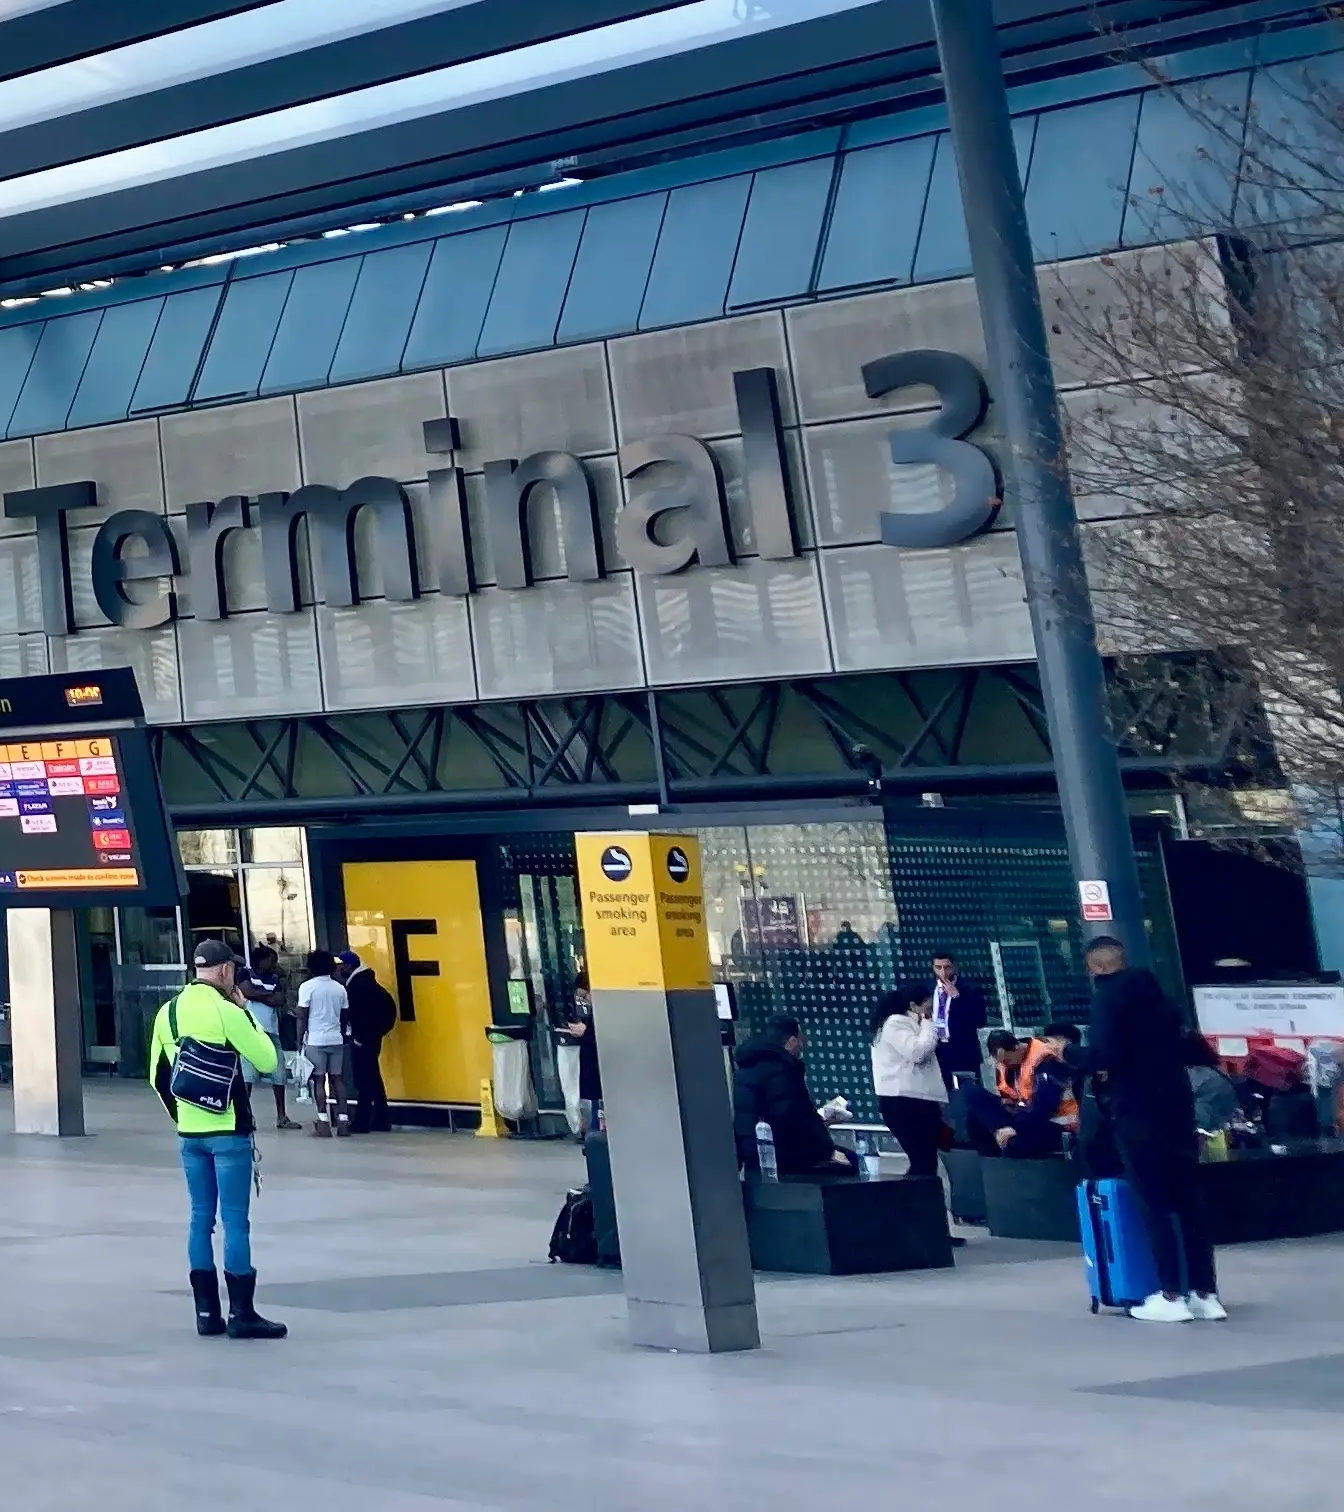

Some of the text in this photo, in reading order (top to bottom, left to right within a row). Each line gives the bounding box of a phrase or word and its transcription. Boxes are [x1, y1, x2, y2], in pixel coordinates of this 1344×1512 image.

[3, 349, 1003, 637] Terminal 3
[21, 745, 30, 760] E
[55, 743, 63, 757] F
[89, 741, 100, 756] G
[589, 891, 650, 906] Passenger
[595, 907, 648, 923] smoking
[611, 926, 637, 937] area
[390, 918, 441, 1022] F
